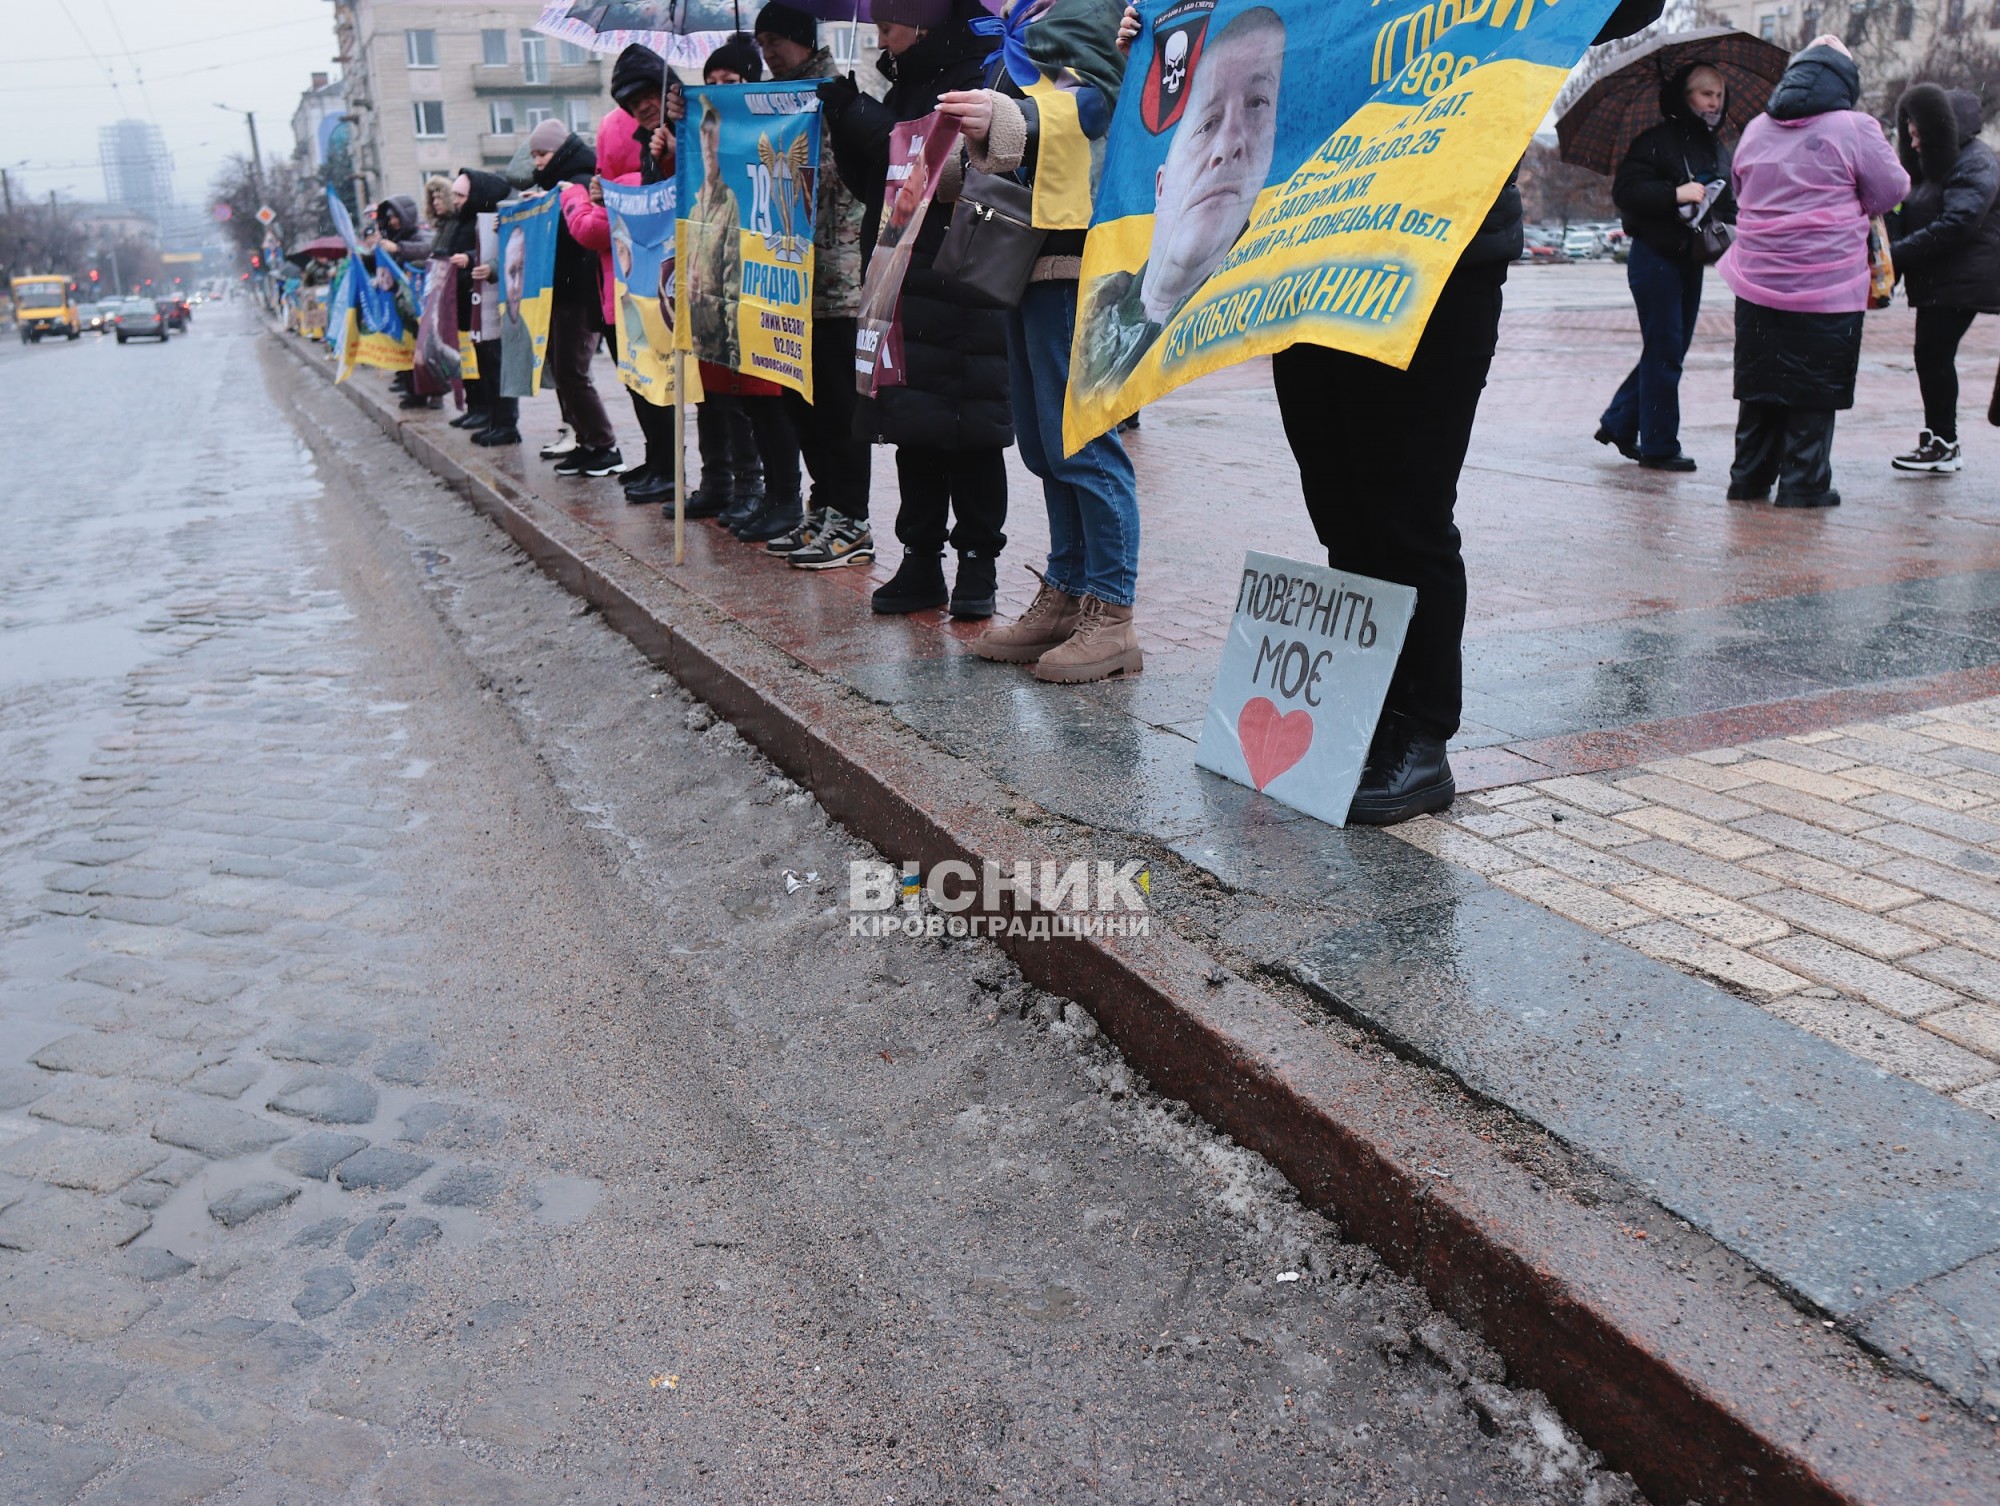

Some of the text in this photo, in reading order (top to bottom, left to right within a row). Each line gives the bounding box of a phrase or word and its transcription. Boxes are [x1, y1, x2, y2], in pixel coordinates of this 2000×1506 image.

[1424, 91, 1473, 123] БАТ.
[1354, 128, 1447, 170] 06.03.25
[746, 163, 772, 239] 79
[1296, 203, 1402, 246] ДОНЕЦЬКА
[1400, 208, 1453, 242] ОБЛ.
[741, 260, 801, 306] ПРЯДКО
[1193, 287, 1263, 350] ТОБОЮ
[1235, 568, 1378, 649] ПОВЕРНІТЬ
[1252, 634, 1333, 707] МОЄ
